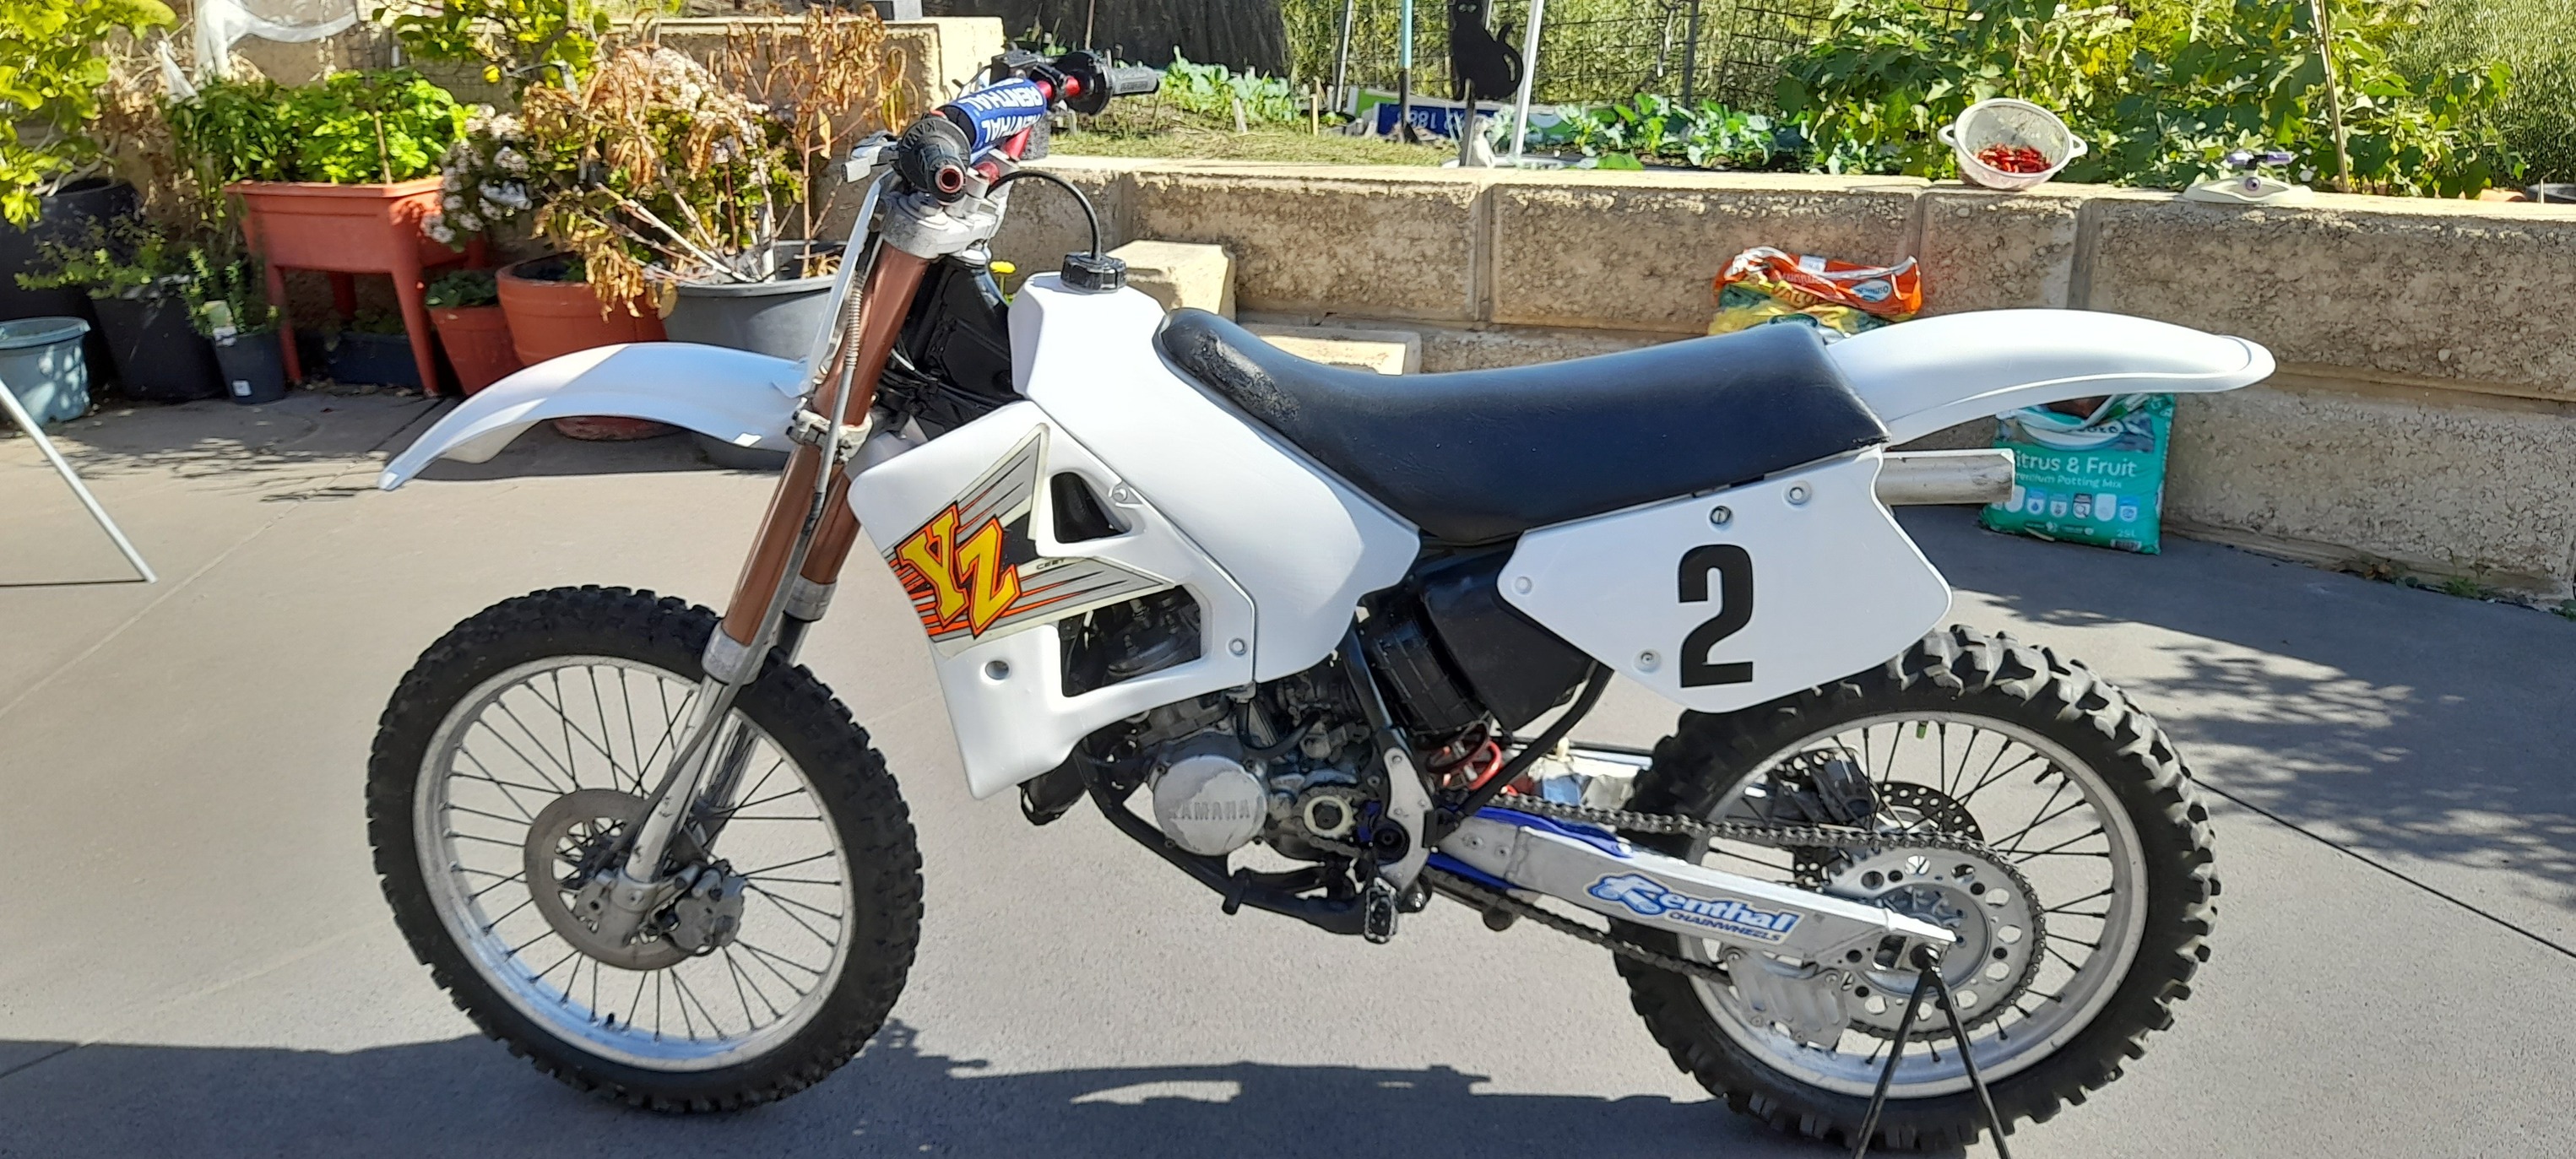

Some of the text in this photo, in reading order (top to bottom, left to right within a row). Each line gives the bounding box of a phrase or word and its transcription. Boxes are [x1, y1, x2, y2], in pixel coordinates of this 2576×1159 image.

[957, 86, 1044, 111] RENTHAL
[980, 113, 1041, 144] RENTHAL
[2016, 450, 2137, 478] itrus & Fruit
[2015, 473, 2122, 489] remium Potting Mix
[894, 501, 1022, 640] YZ
[1678, 544, 1754, 688] 2
[1588, 874, 1803, 933] Renthal
[1668, 912, 1785, 942] CHAINWHEELS
